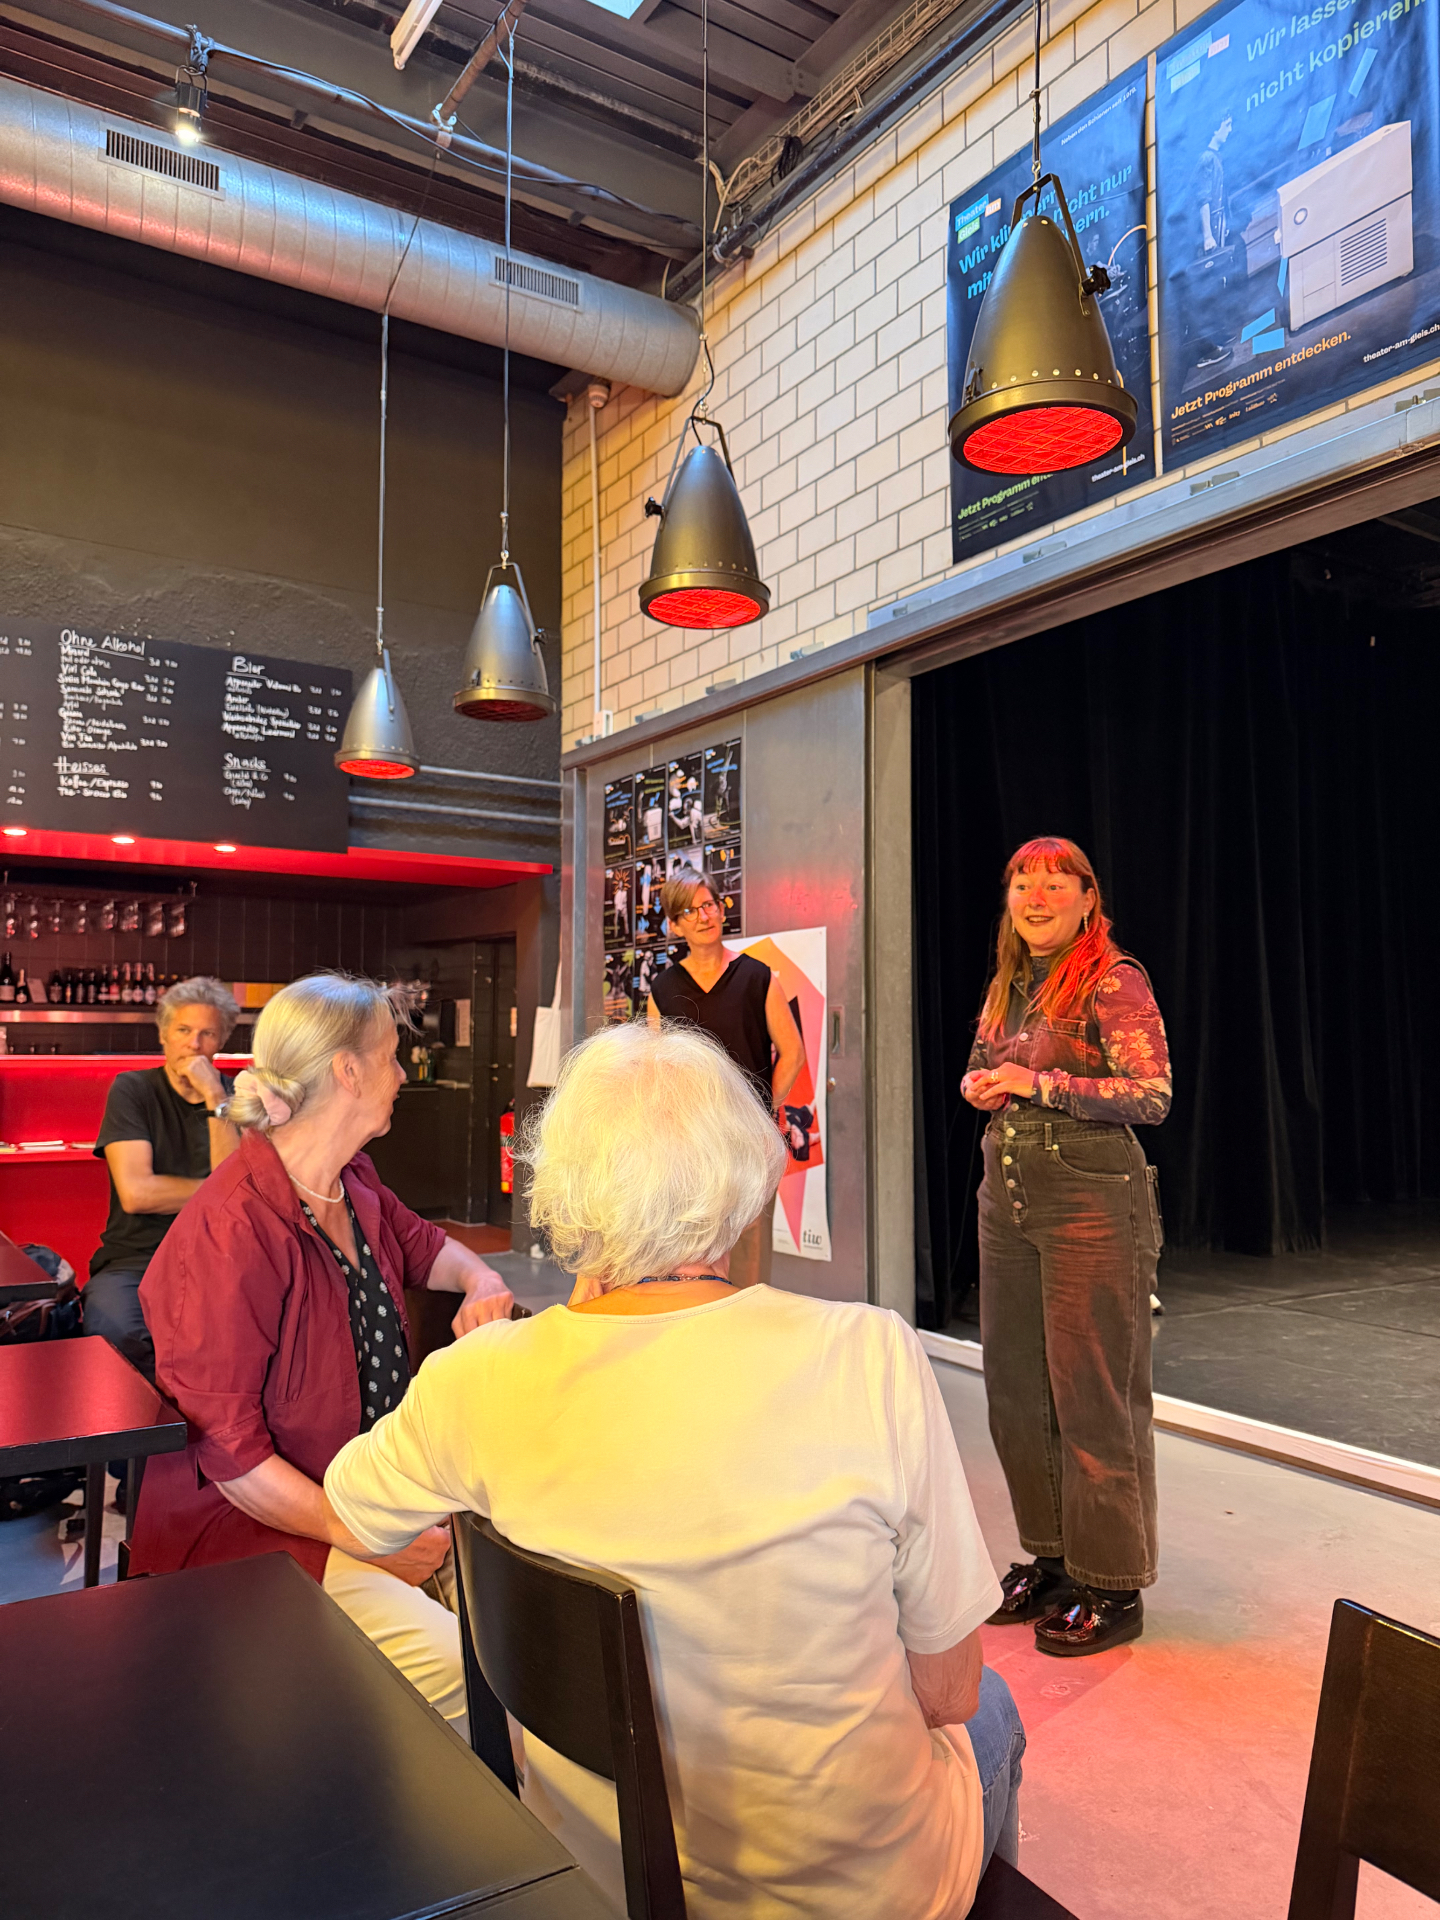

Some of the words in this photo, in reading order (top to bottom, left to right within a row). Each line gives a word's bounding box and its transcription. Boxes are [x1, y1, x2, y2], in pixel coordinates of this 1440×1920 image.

[1245, 26, 1287, 63] Wir
[1290, 0, 1357, 38] lasse
[1245, 61, 1305, 113] nicht
[956, 200, 988, 227] Theater
[986, 201, 1000, 213] am
[958, 244, 989, 274] Wir
[1100, 164, 1132, 196] nur
[959, 220, 980, 240] Gleis
[1171, 395, 1203, 419] Jetzt
[1204, 366, 1273, 406] Programm
[1274, 330, 1352, 373] entdecken.
[957, 501, 982, 520] Jetzt
[981, 479, 1031, 509] Programm
[60, 629, 97, 648] Ohne
[101, 635, 146, 656] Alkohol
[231, 655, 266, 675] Bier
